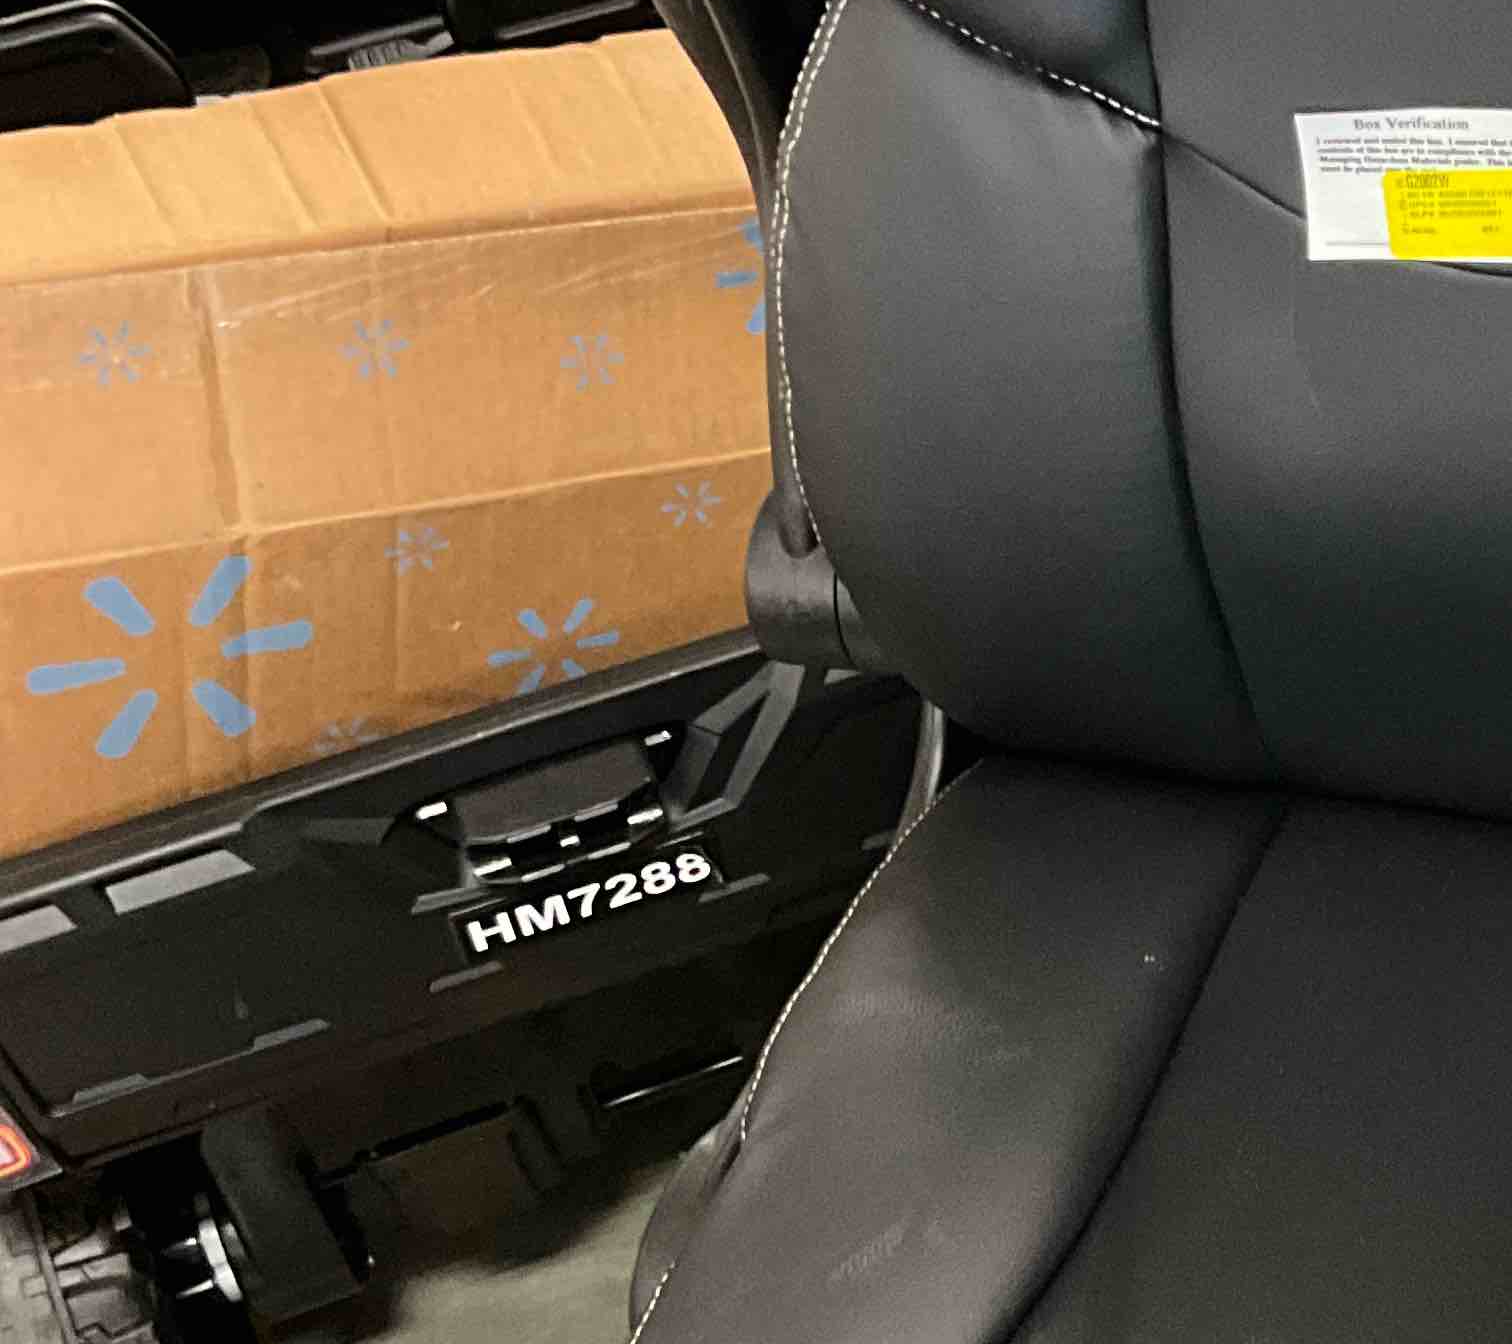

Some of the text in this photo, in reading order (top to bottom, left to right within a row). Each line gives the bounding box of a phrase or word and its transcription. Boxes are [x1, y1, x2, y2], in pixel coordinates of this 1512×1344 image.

[1354, 117, 1470, 131] Box Verification
[467, 852, 712, 953] HM7288
